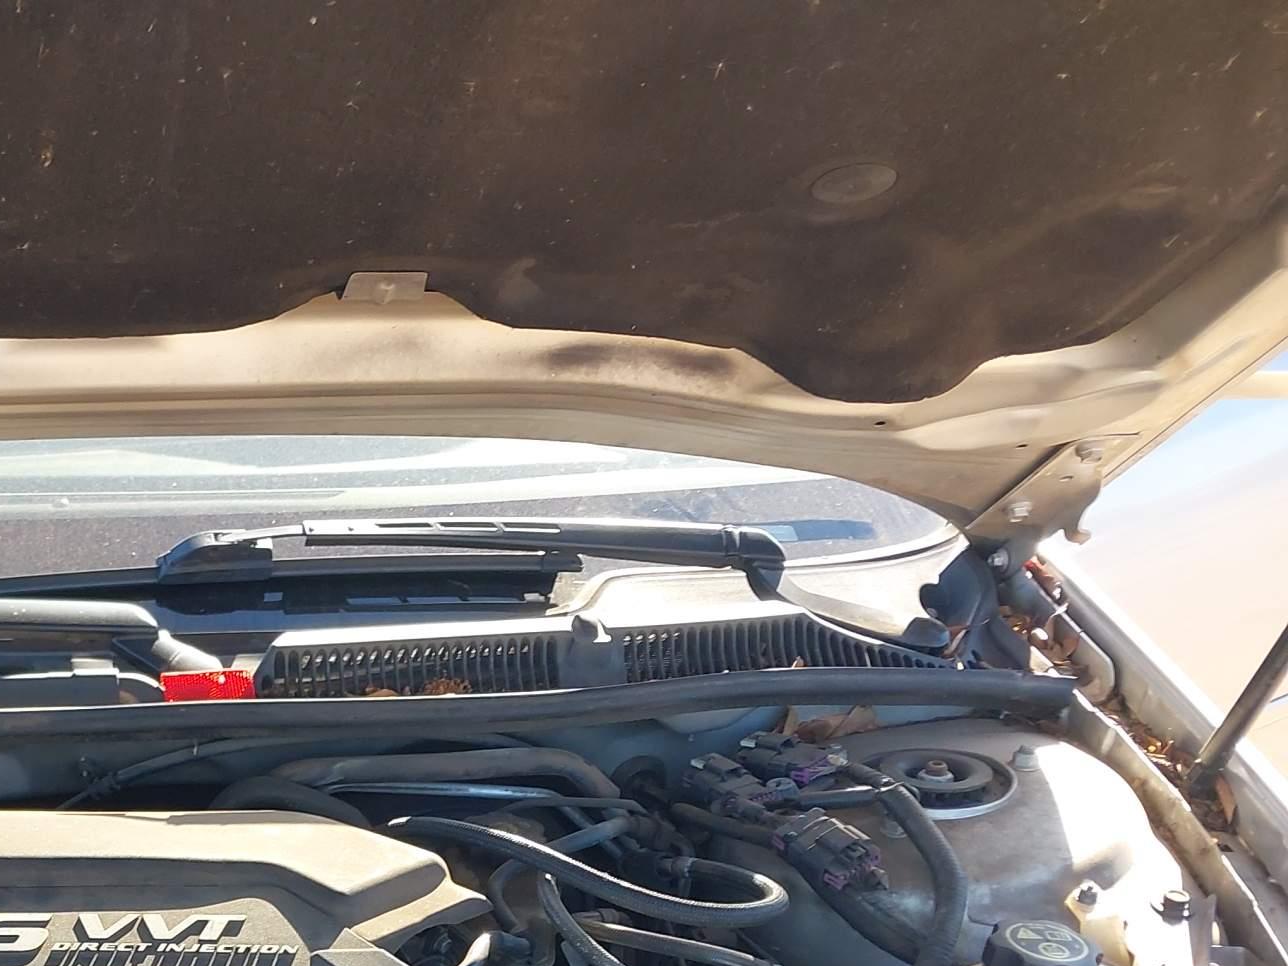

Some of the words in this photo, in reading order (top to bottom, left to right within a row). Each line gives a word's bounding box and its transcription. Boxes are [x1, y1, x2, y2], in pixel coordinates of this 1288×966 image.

[78, 913, 247, 943] VVT
[50, 941, 152, 957] DIRECT
[156, 942, 299, 959] INJECTION
